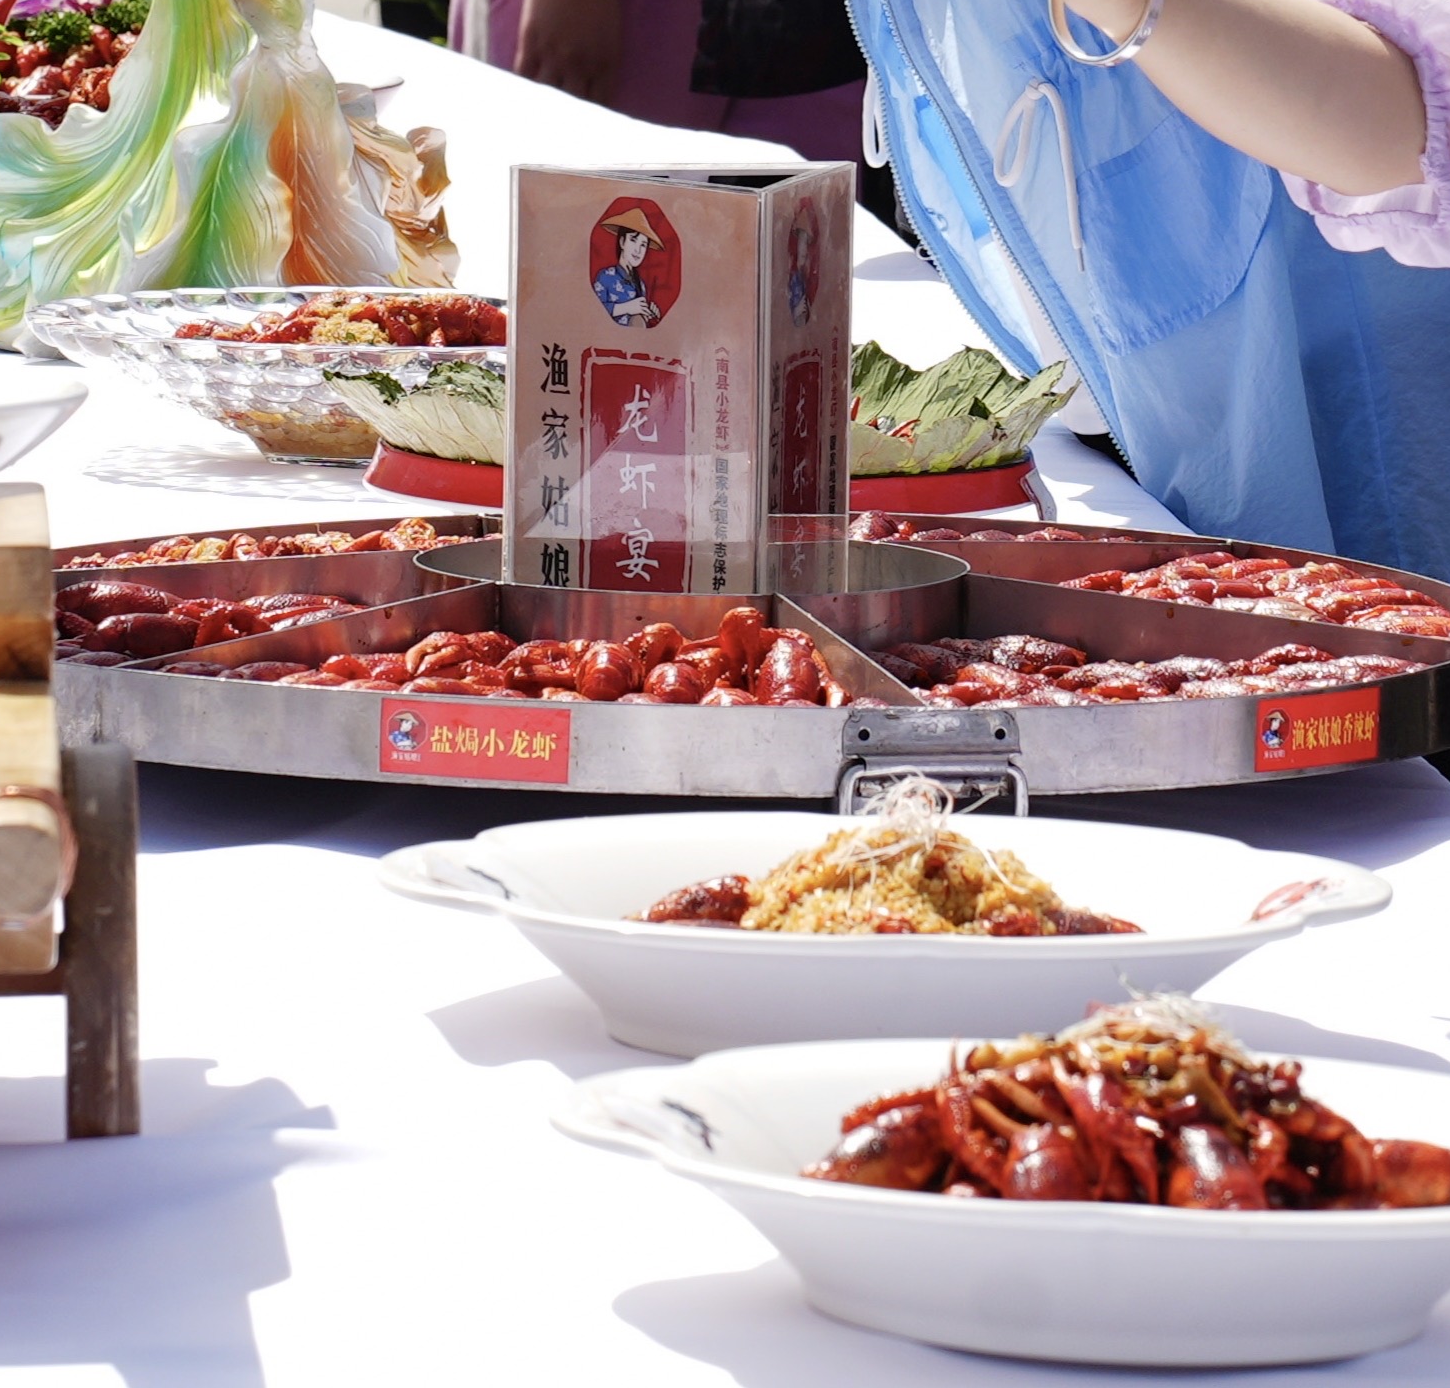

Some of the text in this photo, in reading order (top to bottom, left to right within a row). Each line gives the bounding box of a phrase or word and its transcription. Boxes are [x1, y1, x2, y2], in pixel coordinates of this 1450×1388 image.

[540, 342, 571, 588] 渔家姑娘
[615, 383, 660, 582] 龙虾宴
[430, 725, 557, 761] 盐焗小龙虾
